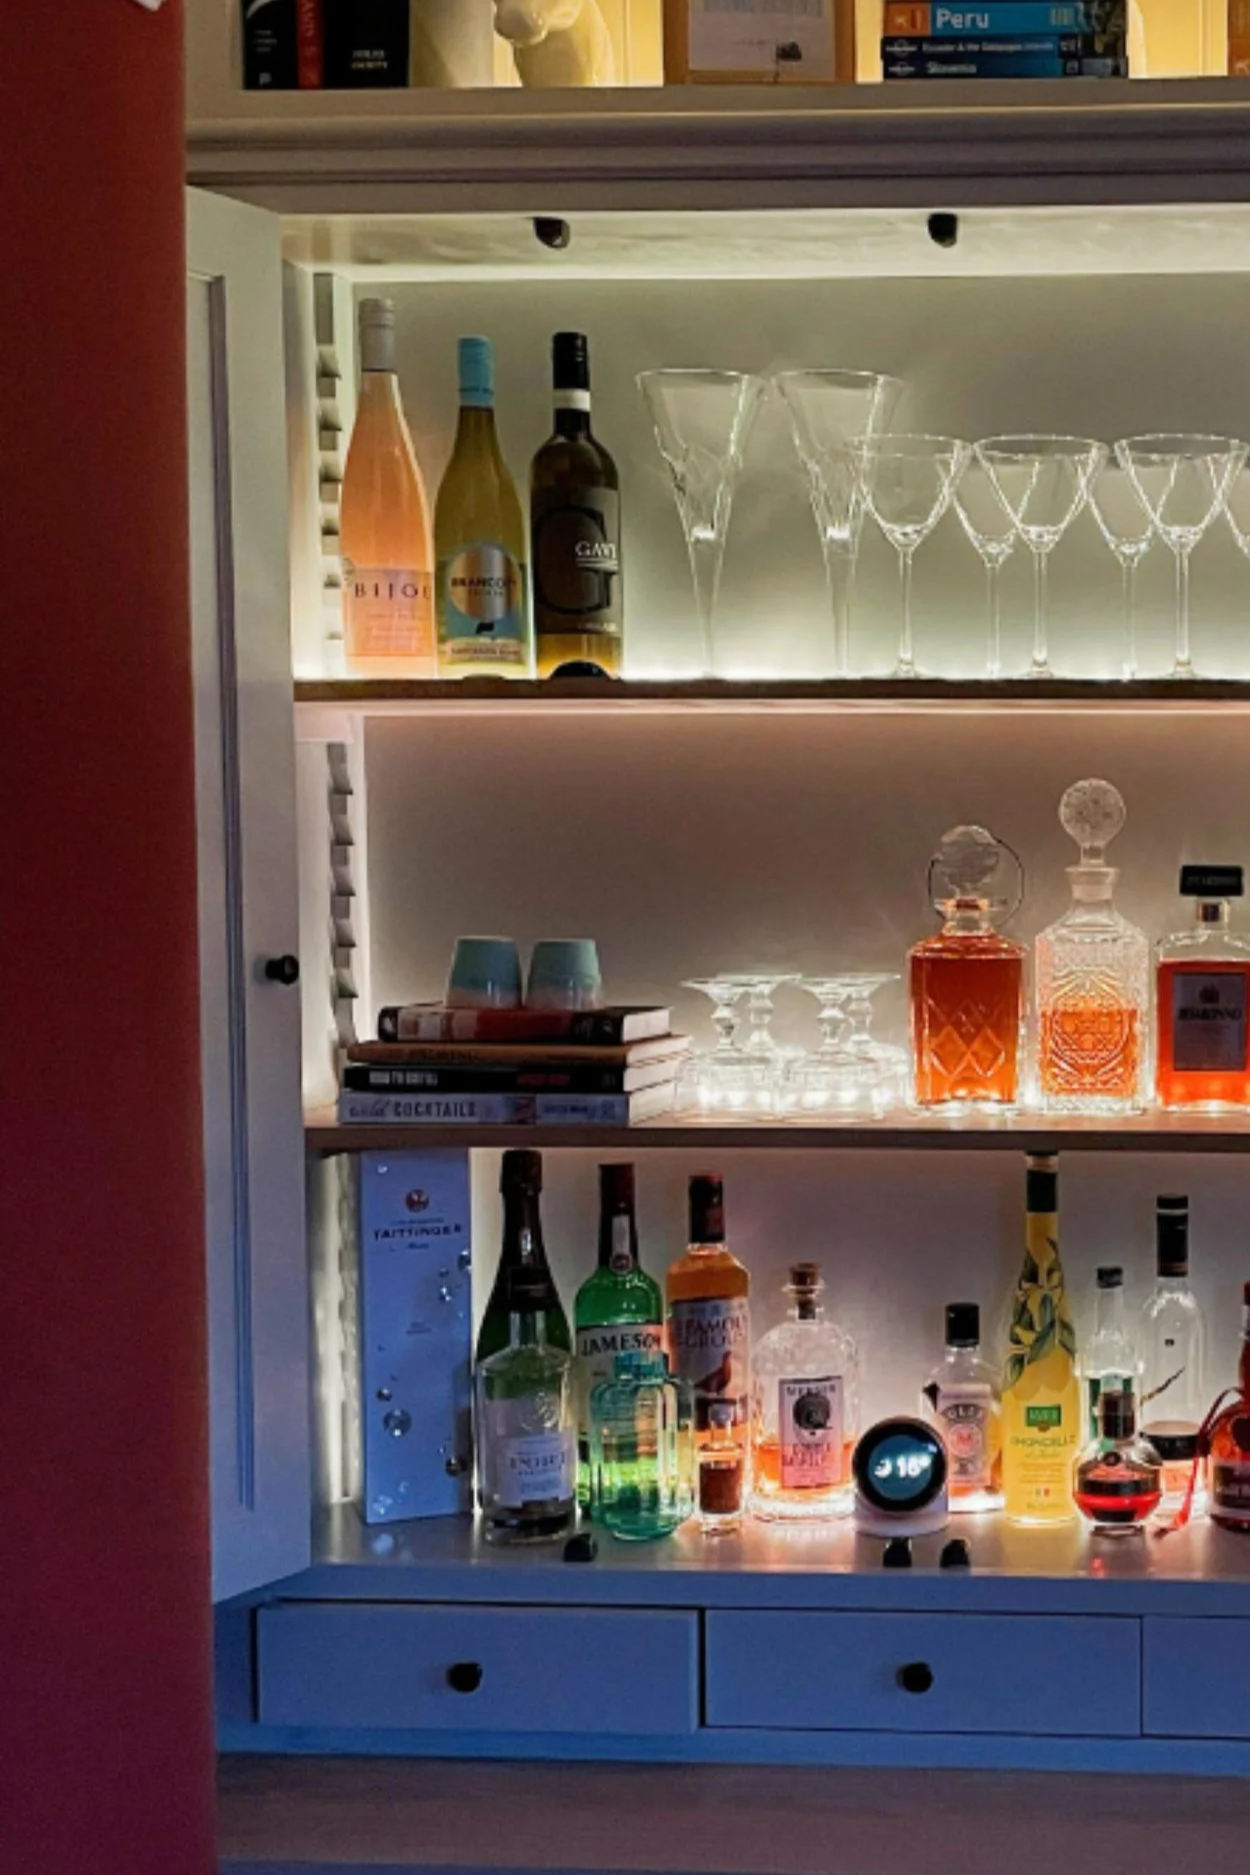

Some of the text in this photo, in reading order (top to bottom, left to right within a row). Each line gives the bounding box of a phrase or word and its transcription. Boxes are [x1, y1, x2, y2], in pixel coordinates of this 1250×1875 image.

[936, 8, 989, 28] Peru
[394, 1101, 476, 1117] COCKTAILS
[374, 1223, 462, 1241] TAITTINGER
